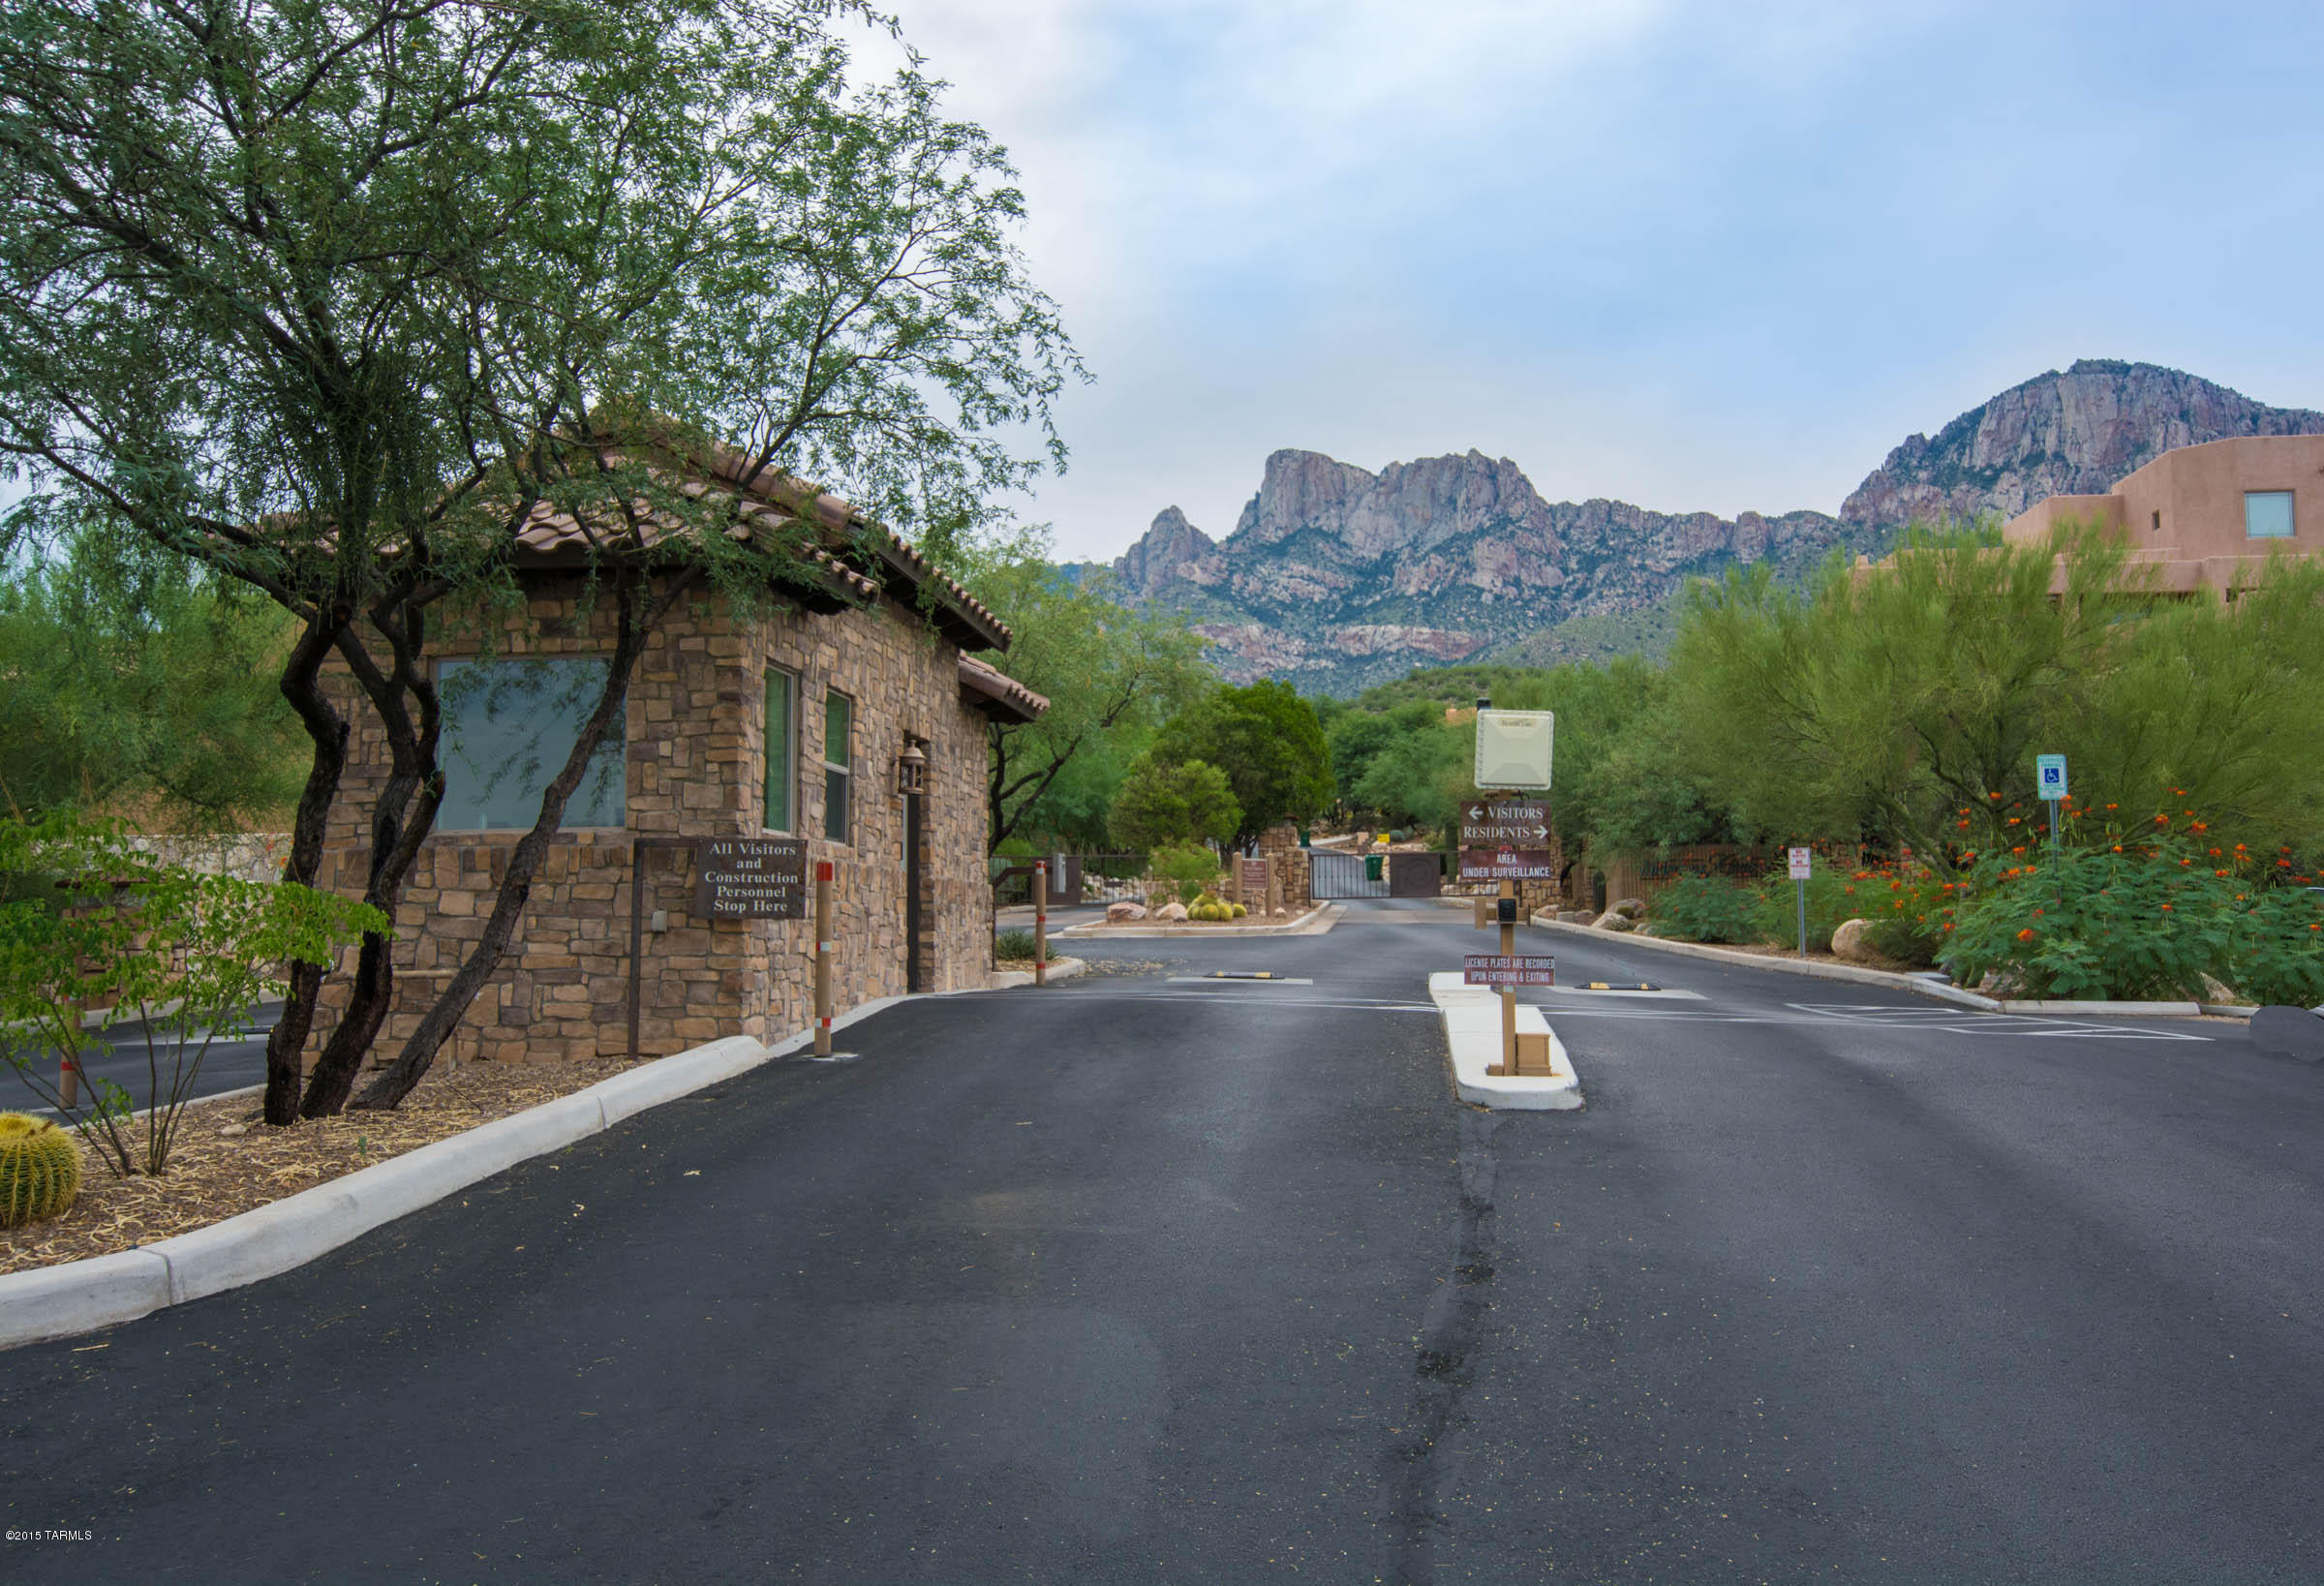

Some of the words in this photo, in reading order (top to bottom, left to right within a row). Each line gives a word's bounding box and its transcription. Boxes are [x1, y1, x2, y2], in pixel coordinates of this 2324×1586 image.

[1487, 806, 1544, 819] VISITORS
[1464, 826, 1530, 839] RESIDENTS
[710, 843, 732, 855] All
[739, 843, 797, 855] Visitors
[736, 858, 762, 869] and
[1496, 853, 1517, 864] AREA
[704, 871, 799, 883] Construction
[1462, 867, 1489, 877] UNDER
[1492, 867, 1550, 877] SURVEILLANCE
[717, 885, 786, 898] Personnel
[713, 900, 747, 914] Stop
[752, 900, 788, 911] Here
